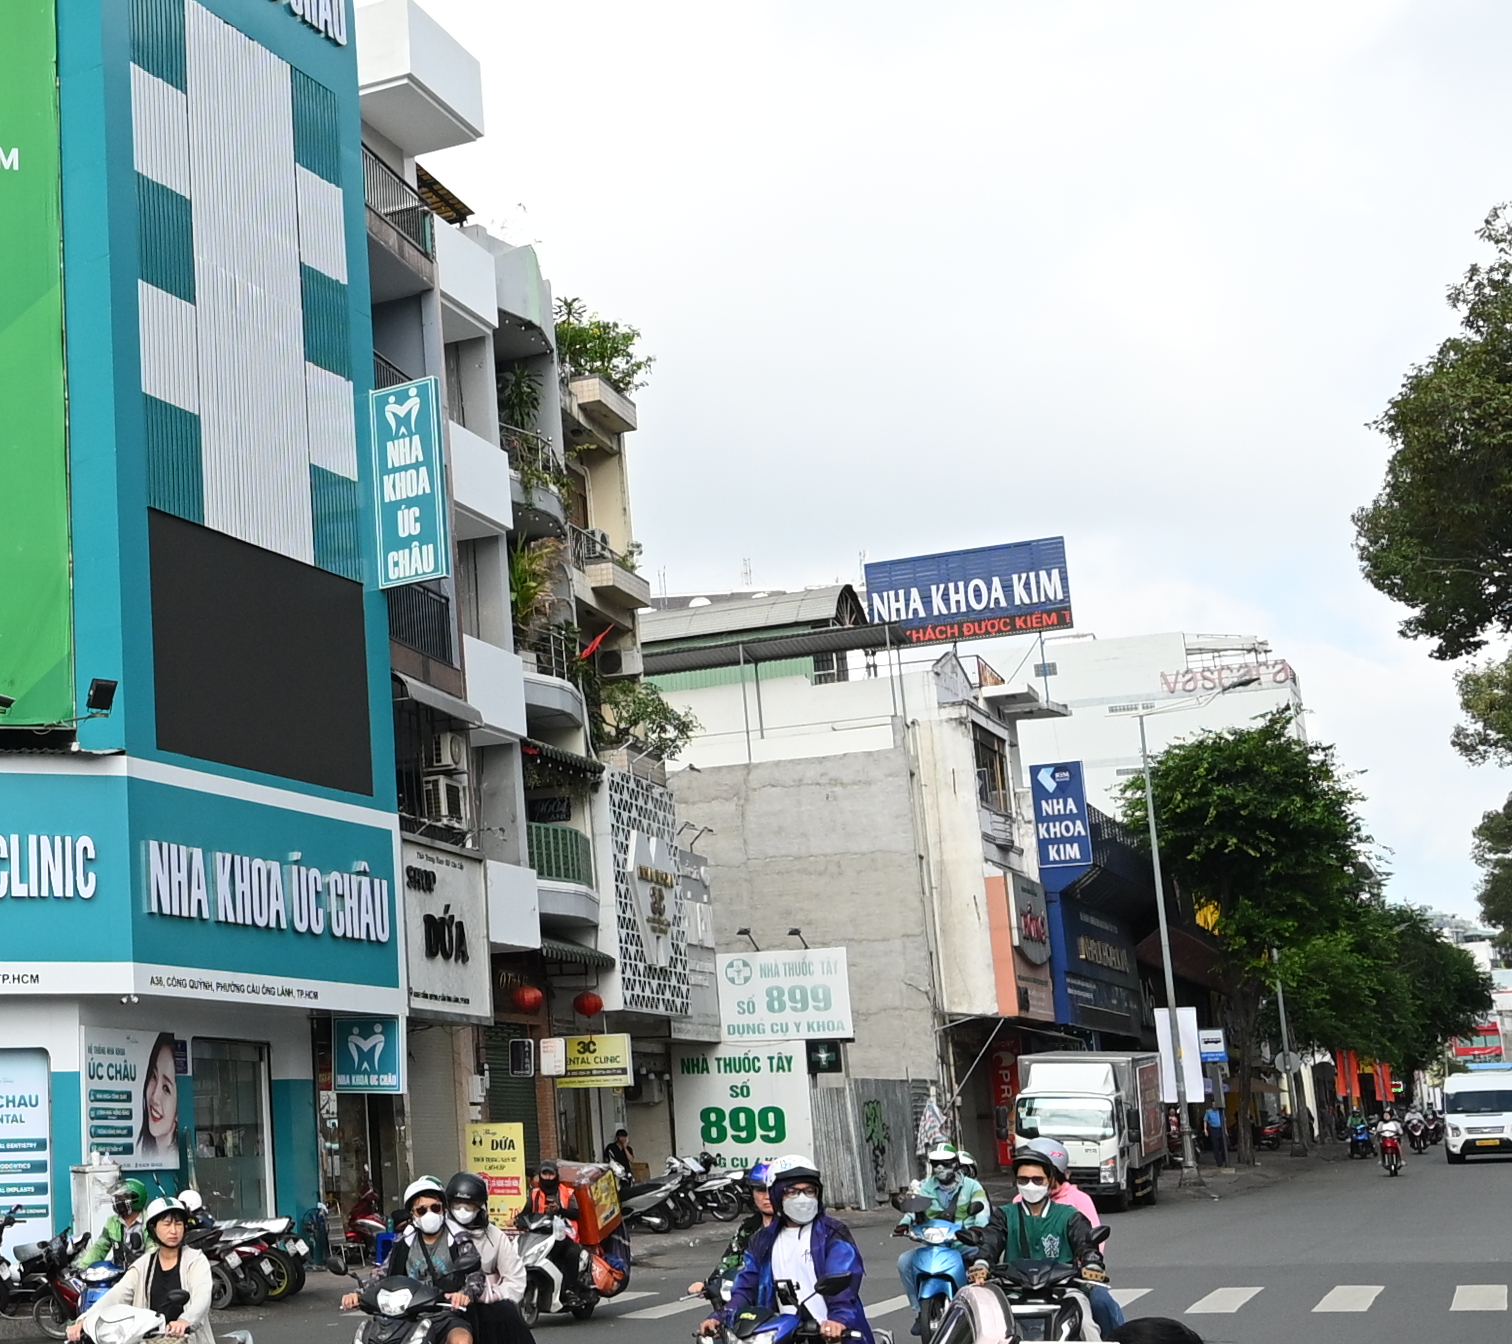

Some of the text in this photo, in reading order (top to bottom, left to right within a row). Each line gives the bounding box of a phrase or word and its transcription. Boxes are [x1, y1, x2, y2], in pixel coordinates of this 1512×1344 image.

[386, 435, 423, 470] NHA
[383, 466, 431, 503] KHOA
[397, 506, 421, 538] ÚC
[388, 541, 434, 580] CHÂU
[871, 568, 1064, 623] NHA KHOA KIM
[1040, 797, 1077, 816] NHA
[1037, 819, 1086, 839] KHOA
[1048, 842, 1081, 862] KIM
[148, 840, 391, 944] NHA KHOA ÚC CHÂU
[406, 865, 437, 893] SHOP
[423, 904, 470, 964] DỨA
[736, 984, 832, 1015] SỐ 899
[726, 1019, 845, 1039] DỤNG CỤ Y KHOA
[576, 1040, 597, 1055] 3C
[680, 1049, 794, 1074] NHÀ THUỐC TÂY
[88, 1059, 137, 1083] ÚC CHÂU
[729, 1078, 751, 1098] SỐ
[700, 1106, 788, 1144] 899
[491, 1136, 516, 1151] DỨA
